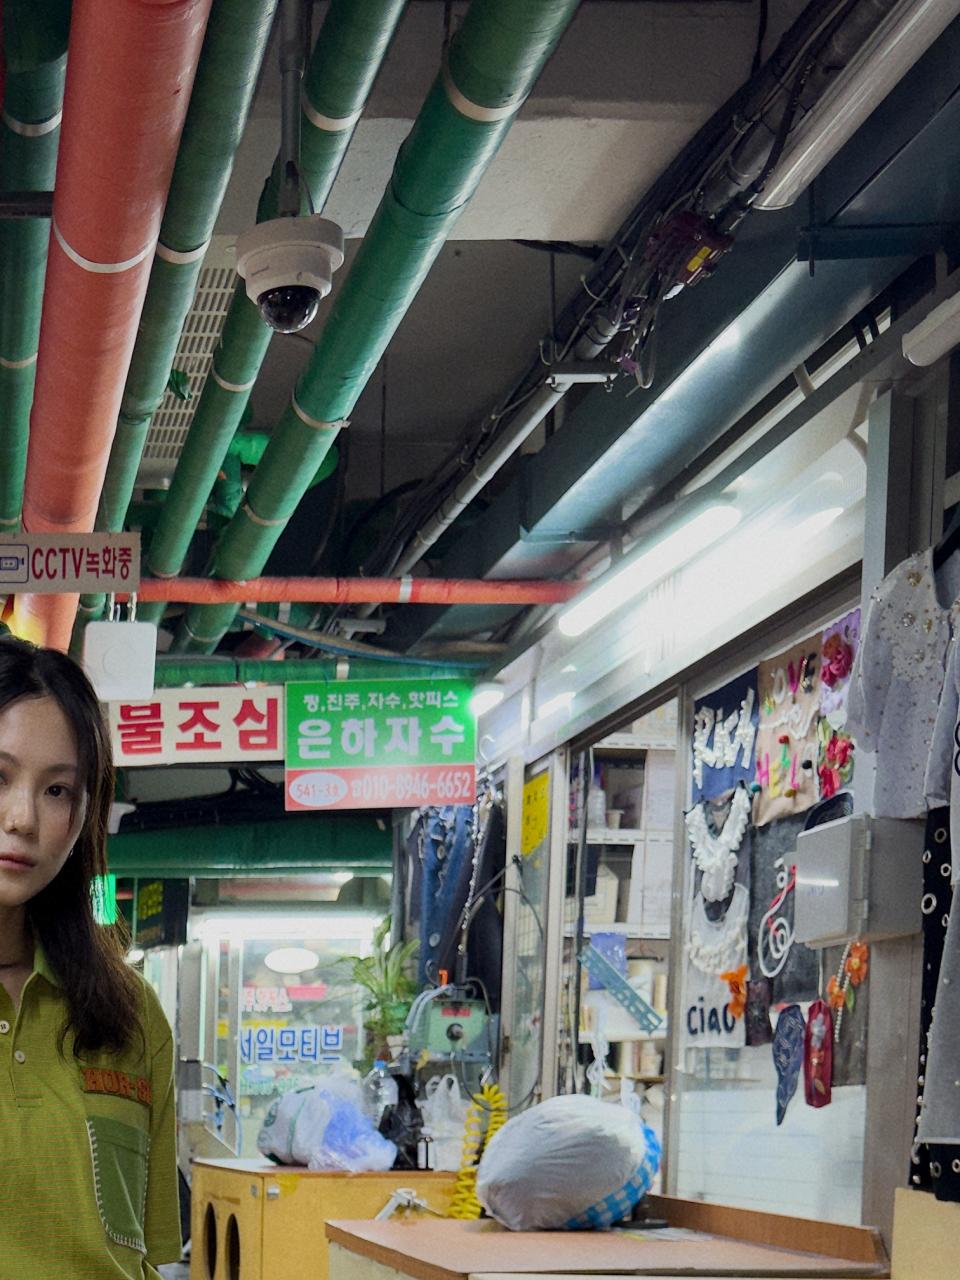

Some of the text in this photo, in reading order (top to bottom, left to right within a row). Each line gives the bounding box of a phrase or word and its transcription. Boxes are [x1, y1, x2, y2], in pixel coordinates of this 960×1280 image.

[31, 546, 133, 581] CCTV녹화중
[117, 697, 279, 756] 불조심
[297, 715, 465, 760] 은하자수
